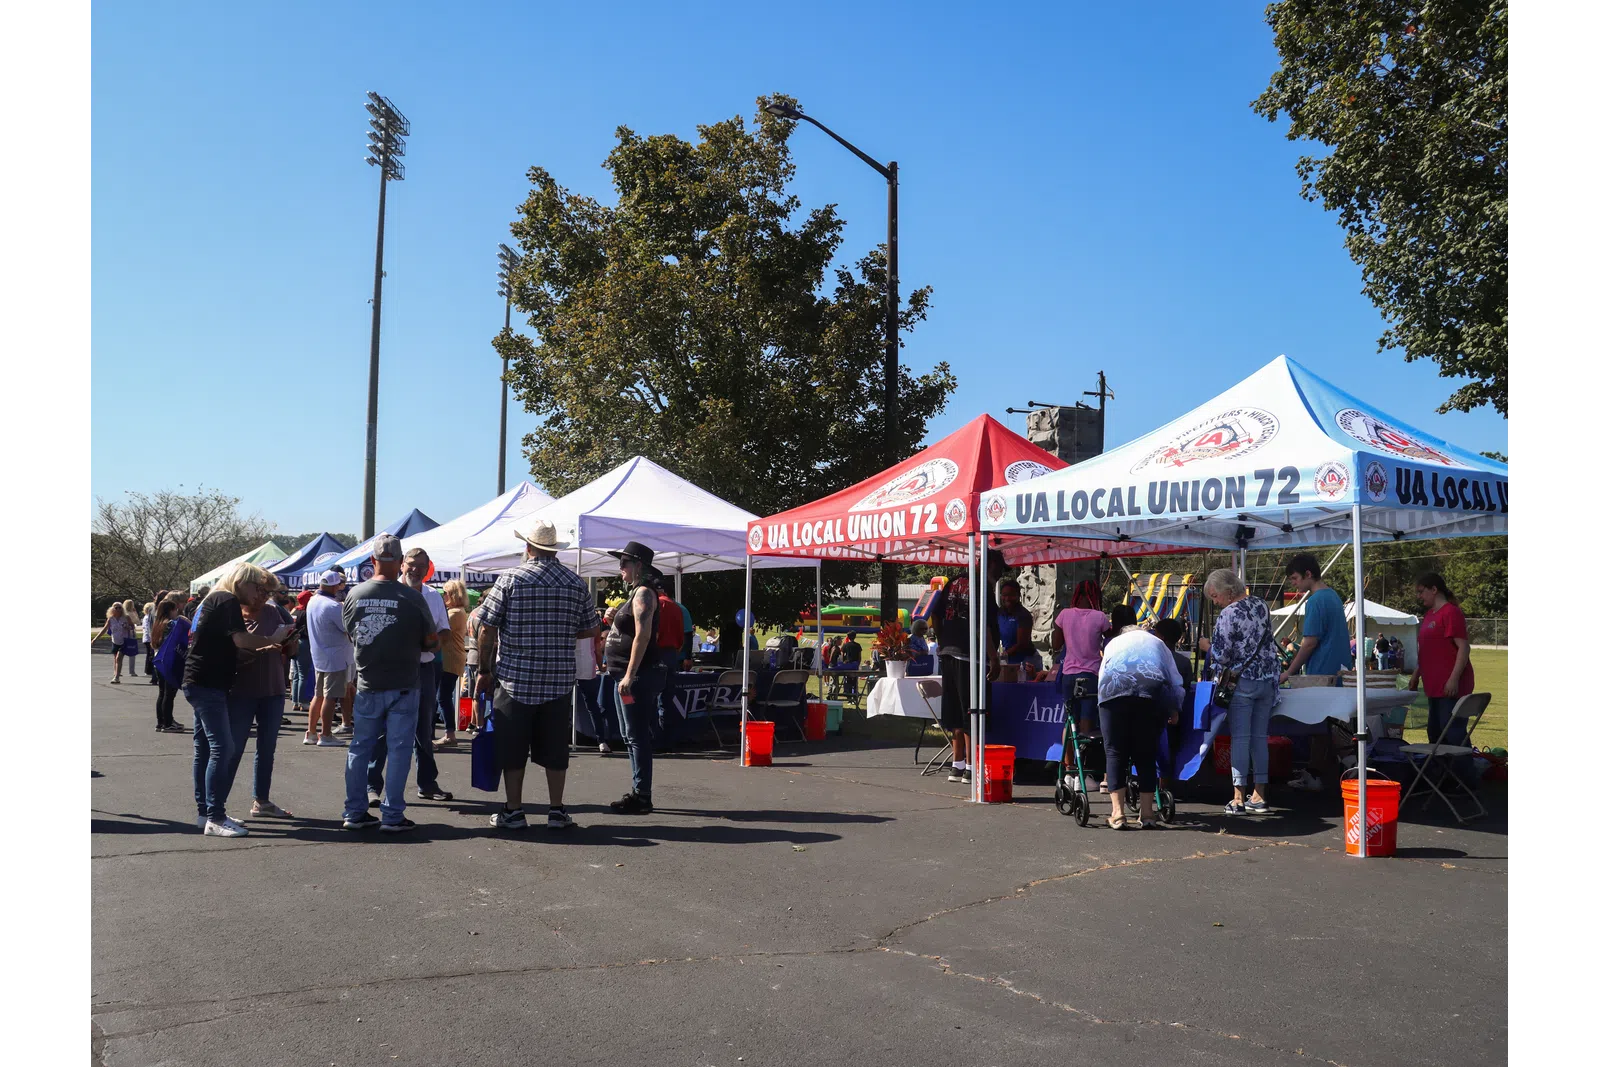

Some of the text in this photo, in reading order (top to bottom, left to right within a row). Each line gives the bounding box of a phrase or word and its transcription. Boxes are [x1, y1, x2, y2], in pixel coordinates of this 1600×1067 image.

[1016, 492, 1050, 524] UA
[1057, 486, 1142, 521] LOCAL
[1148, 476, 1246, 515] UNION
[1254, 466, 1301, 506] 72
[1396, 467, 1429, 505] UA
[1432, 472, 1497, 512] LOCAL
[767, 503, 938, 550] UA LOCAL UNION 72
